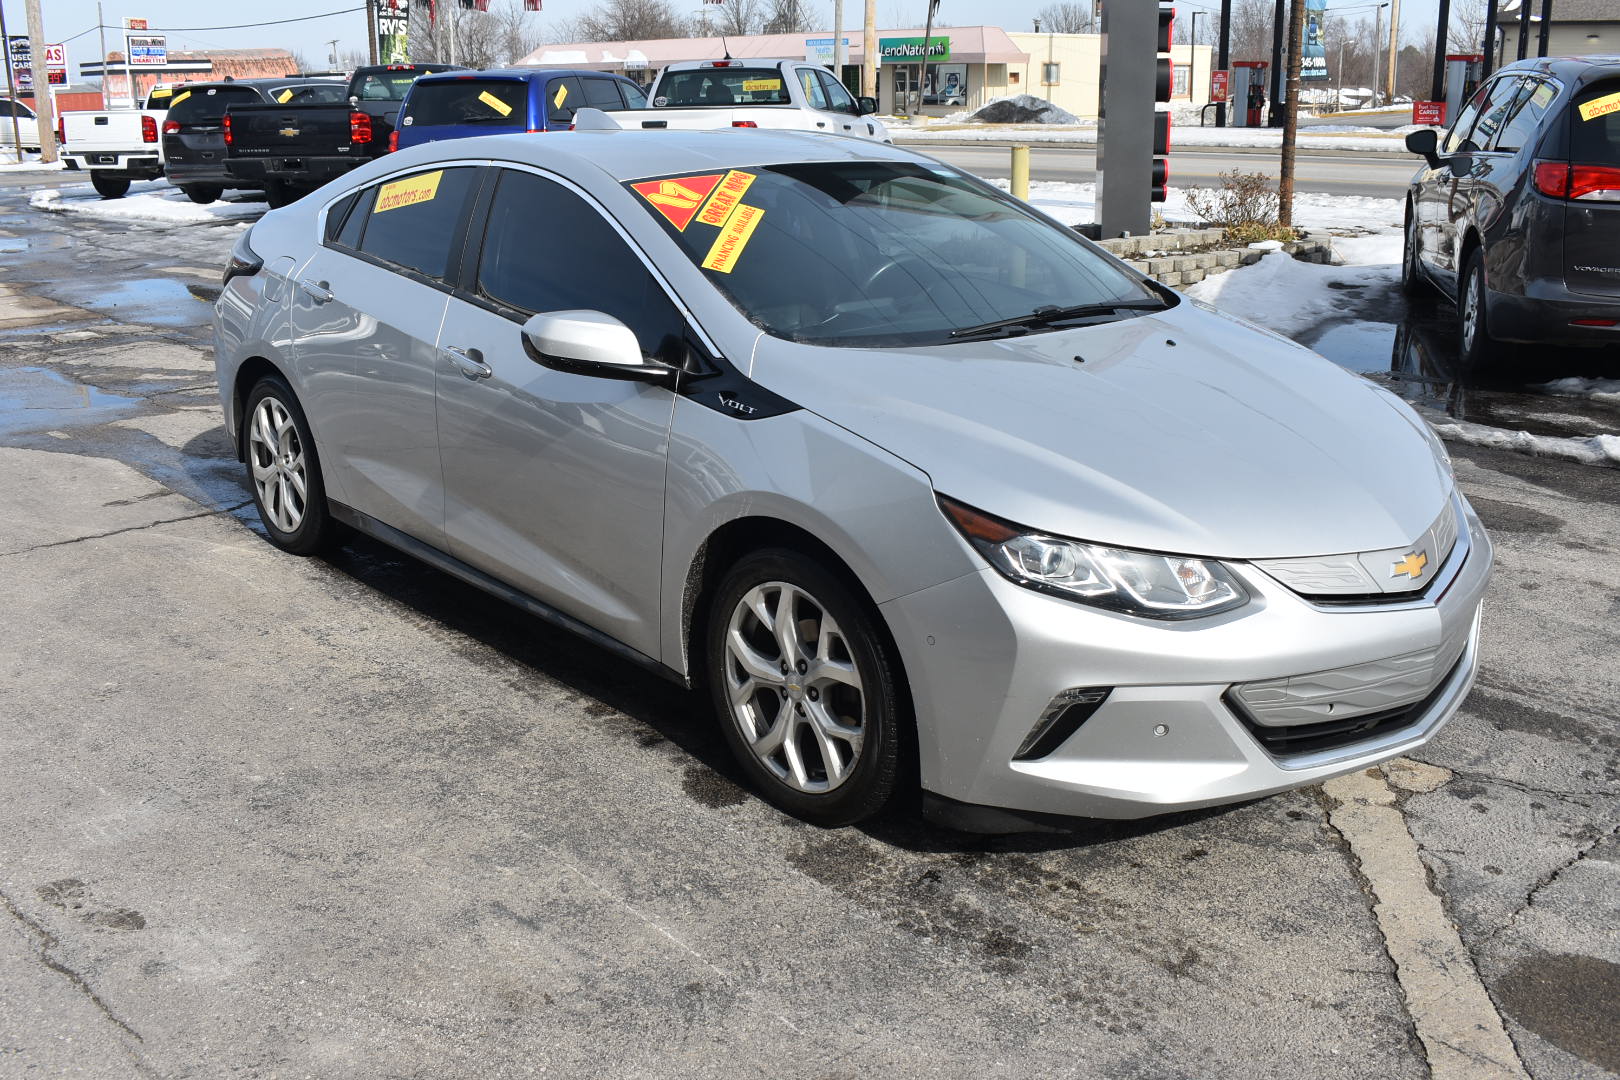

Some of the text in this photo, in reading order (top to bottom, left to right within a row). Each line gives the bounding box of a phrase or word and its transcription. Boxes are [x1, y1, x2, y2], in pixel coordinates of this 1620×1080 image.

[46, 49, 62, 61] AS
[380, 188, 432, 209] abcmotors.com
[702, 172, 753, 224] GREAT MPG
[711, 207, 756, 271] FINANCING AVAILABLE
[718, 393, 758, 414] VOLT
